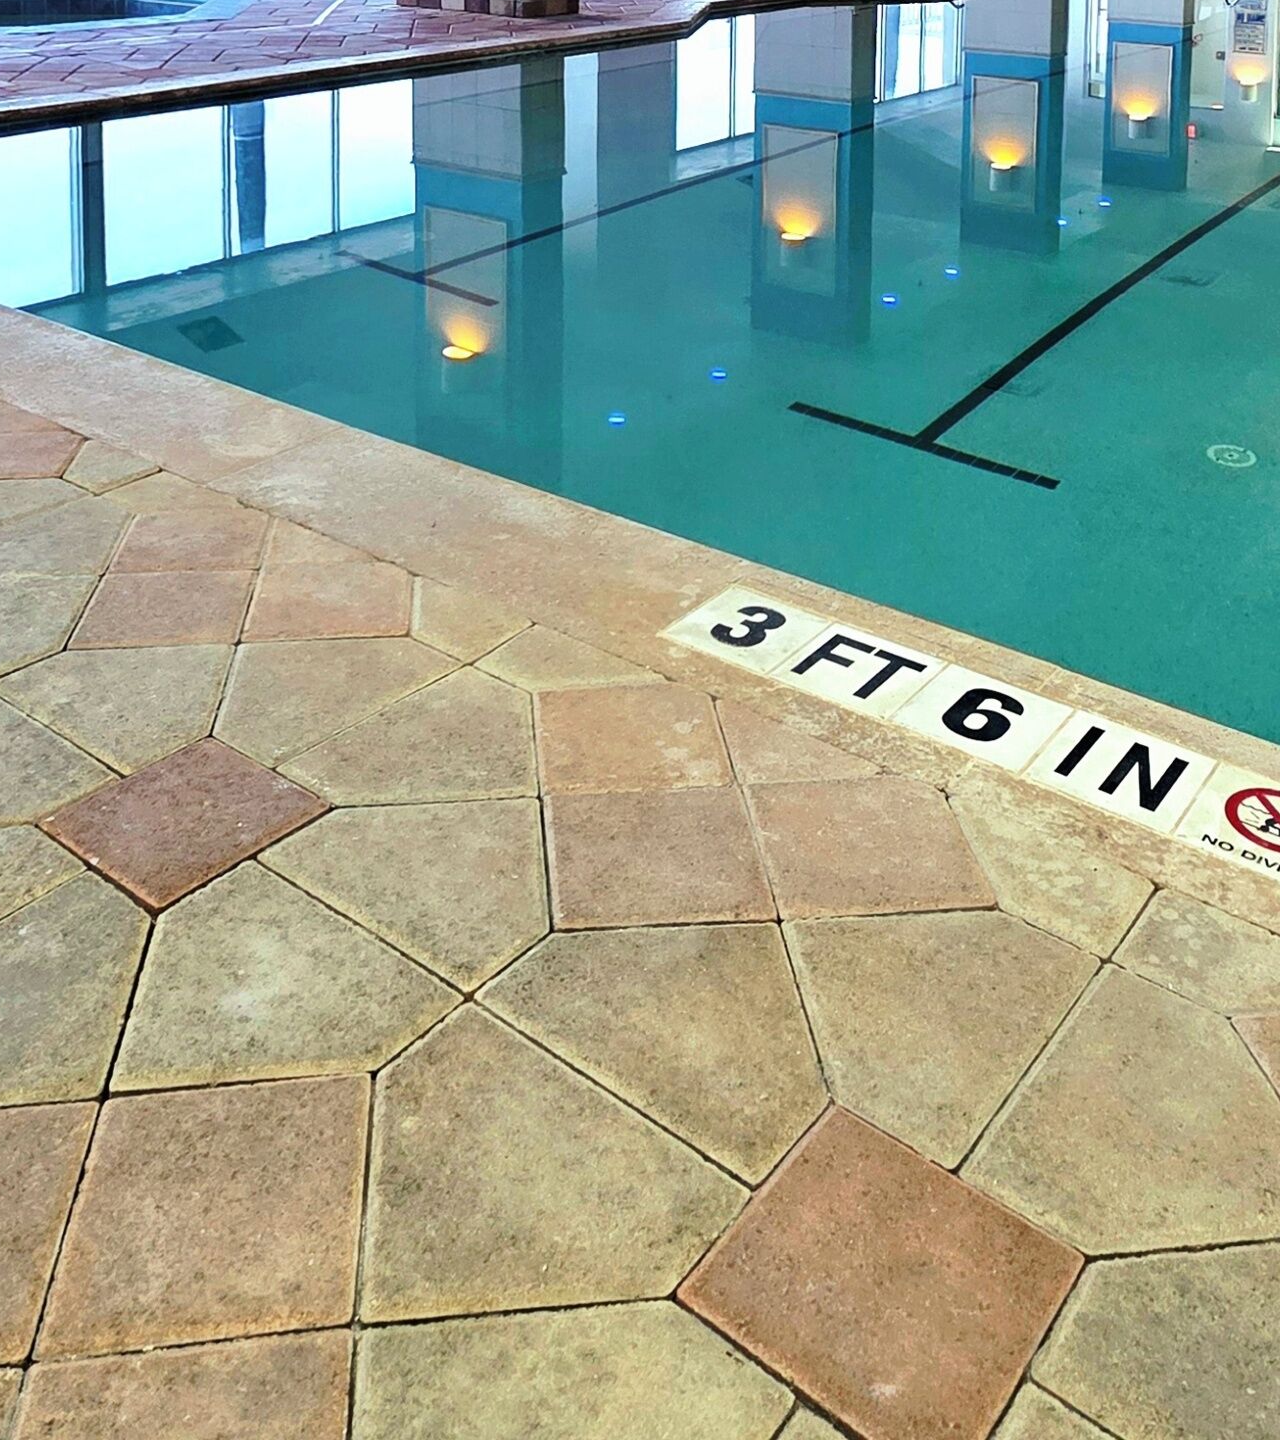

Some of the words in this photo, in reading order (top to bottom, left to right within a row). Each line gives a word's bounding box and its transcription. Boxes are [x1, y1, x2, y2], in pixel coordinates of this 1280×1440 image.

[710, 606, 786, 647] 3
[791, 634, 927, 699] FT
[942, 688, 1024, 741] 6
[1054, 726, 1190, 812] IN
[1201, 834, 1234, 851] NO
